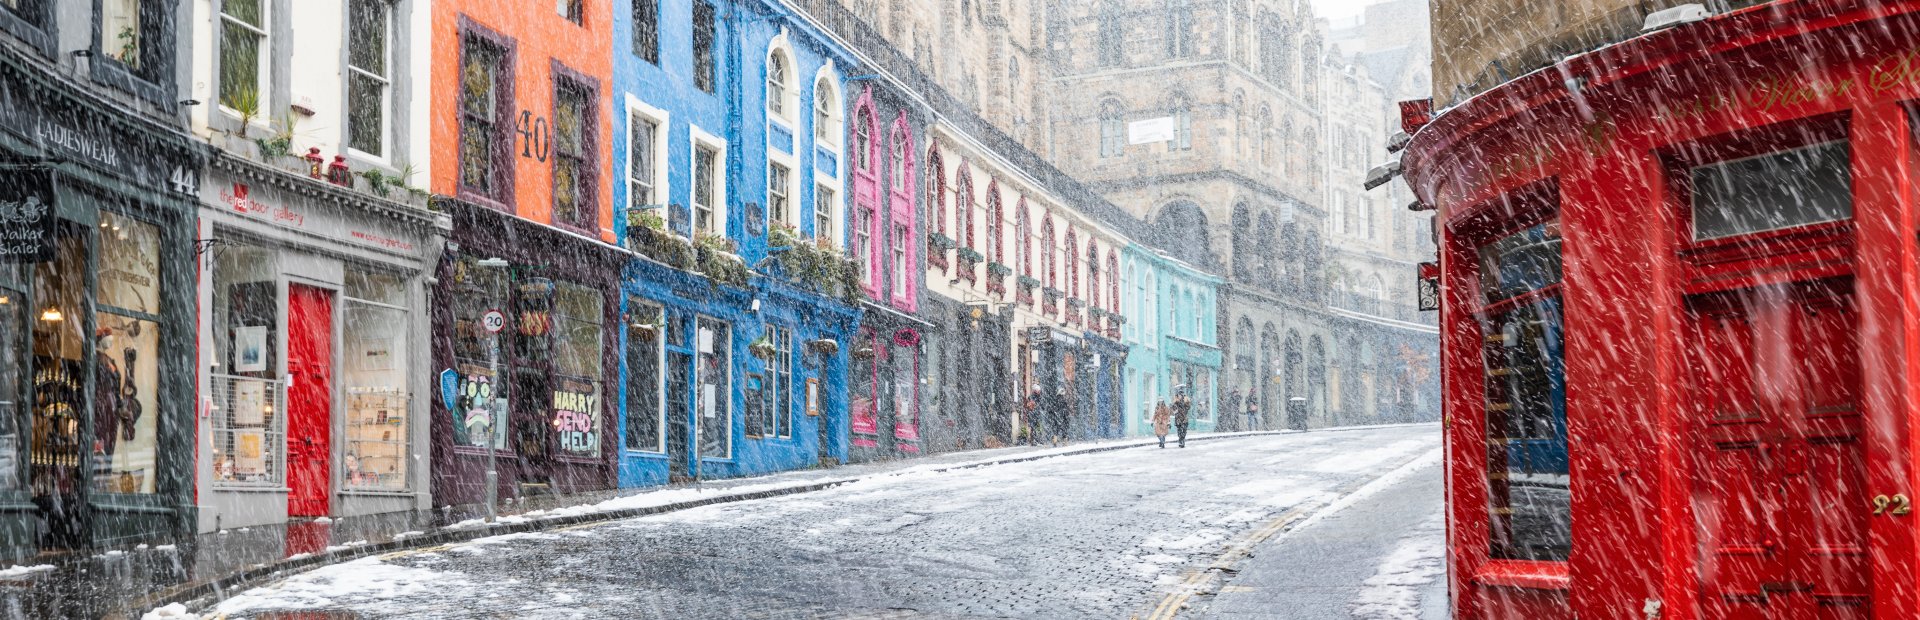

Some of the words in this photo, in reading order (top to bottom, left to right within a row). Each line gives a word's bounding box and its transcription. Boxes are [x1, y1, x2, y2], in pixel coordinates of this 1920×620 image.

[37, 115, 117, 167] LADIESWEAR
[515, 111, 548, 162] 40
[220, 187, 233, 204] the
[234, 194, 247, 208] red
[250, 197, 270, 213] door
[273, 204, 303, 226] gallery
[486, 316, 502, 327] 20
[556, 409, 591, 433] SEND
[1872, 494, 1909, 515] 92
